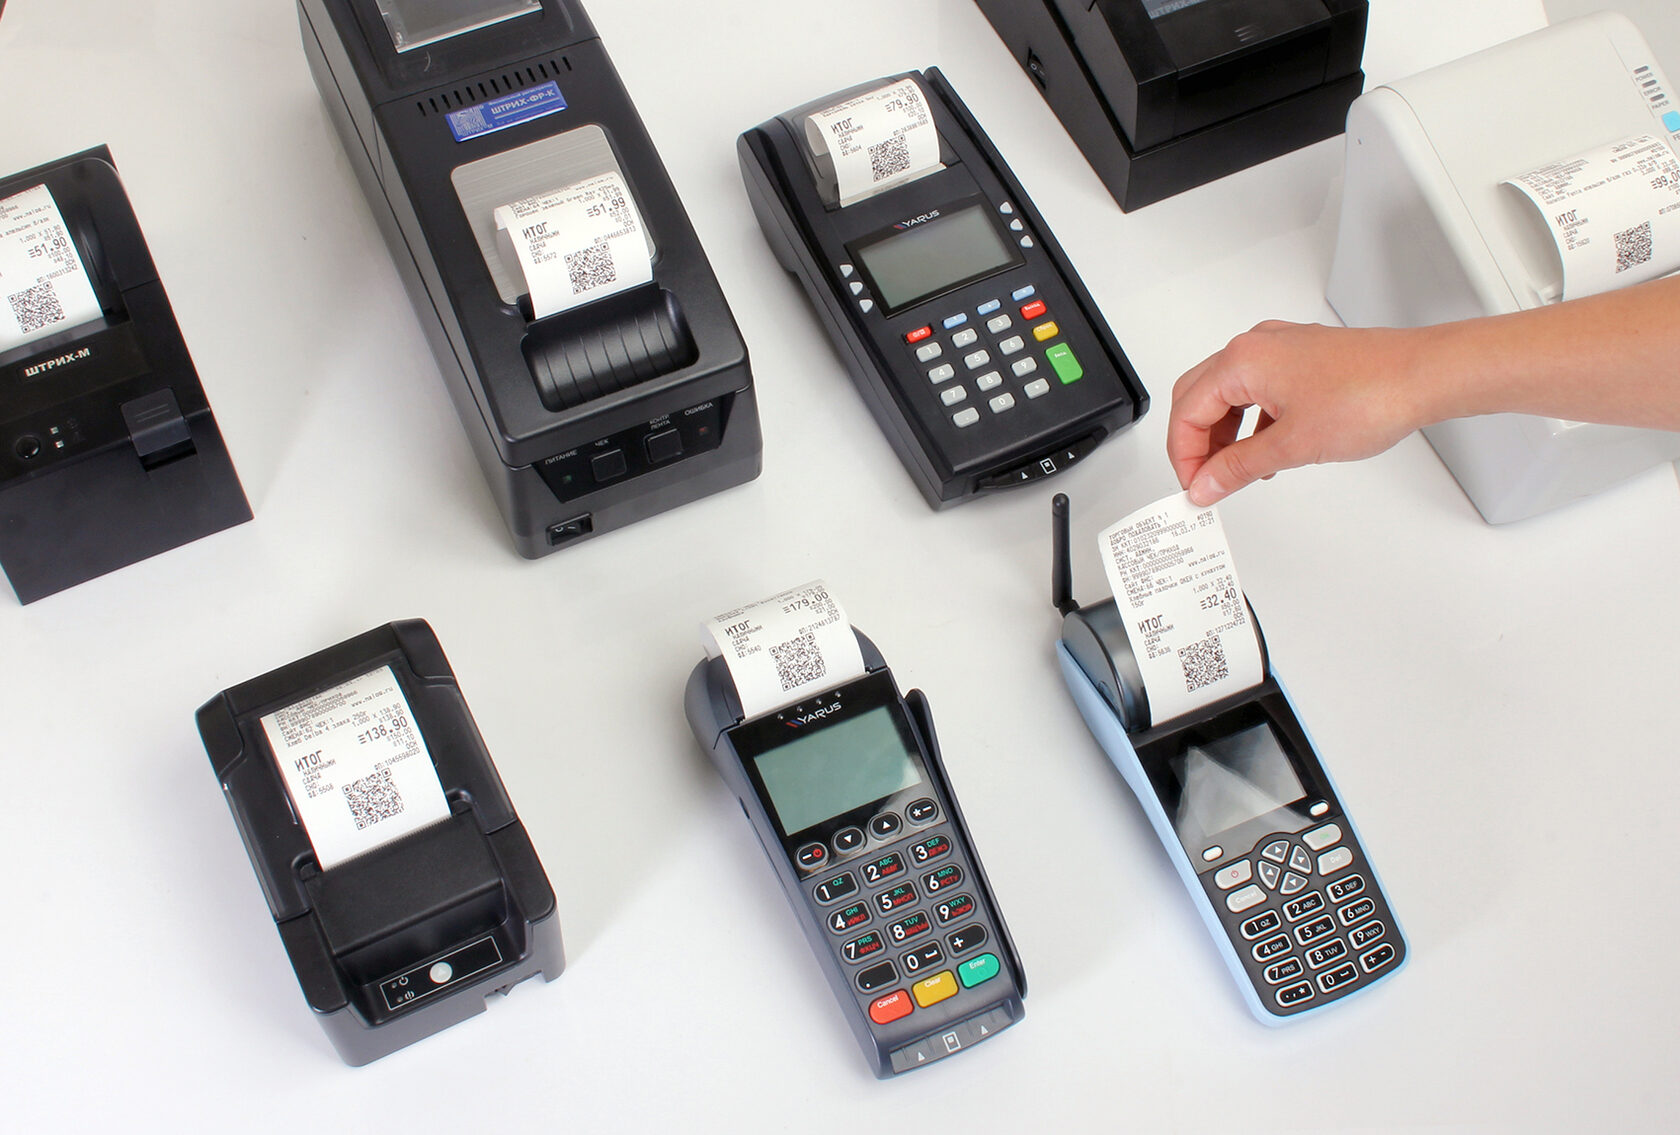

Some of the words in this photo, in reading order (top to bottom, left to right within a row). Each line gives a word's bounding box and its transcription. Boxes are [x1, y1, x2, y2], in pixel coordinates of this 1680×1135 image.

[491, 89, 556, 114] ШТРИХ-ФР-К
[831, 118, 852, 134] ИТОГ
[902, 210, 940, 227] YARUS
[1555, 209, 1577, 226] ИТОГ
[522, 222, 547, 239] ИТОГ
[24, 347, 91, 378] ШТРИХ-М
[684, 402, 713, 416] ОШИБКА
[545, 450, 578, 465] ПИТАНИЕ
[1110, 535, 1126, 546] ДОБРО
[725, 620, 749, 636] ИТОГ
[1138, 614, 1163, 633] ИТОГ
[1144, 636, 1161, 646] СДАЧА
[797, 702, 842, 724] YARUS
[295, 750, 322, 771] ИТОГ
[302, 772, 321, 785] СДАЧА
[916, 845, 928, 860] 3
[926, 838, 940, 847] DEF
[866, 865, 881, 881] 2
[879, 857, 894, 867] ABC
[929, 875, 939, 890] 6
[937, 867, 954, 877] MNO
[820, 885, 830, 900] 1
[832, 877, 844, 887] QZ
[1334, 884, 1344, 896] 3
[1345, 881, 1358, 891] DEF
[881, 894, 893, 910] 5
[893, 887, 905, 896] JKL
[939, 904, 949, 920] 9
[948, 897, 966, 907] WXY
[1292, 903, 1302, 915] 2
[1302, 899, 1317, 910] ABC
[1347, 907, 1355, 918] 6
[1355, 904, 1370, 914] MNO
[835, 914, 846, 929] 4
[845, 906, 859, 916] GHI
[893, 924, 905, 940] 8
[903, 916, 919, 926] TUV
[1251, 921, 1259, 932] 1
[1304, 926, 1312, 938] 5
[1357, 931, 1364, 942] 9
[1365, 927, 1380, 938] WXY
[846, 942, 855, 959] 7
[857, 935, 873, 946] PRS
[1263, 944, 1271, 955] 4
[1271, 941, 1283, 951] GHI
[1315, 950, 1324, 961] 8
[1324, 946, 1338, 957] TUV
[906, 954, 919, 970] 0
[968, 958, 986, 970] Enter
[1272, 967, 1280, 978] 7
[1281, 964, 1296, 975] PRS
[924, 977, 941, 988] Clear
[1326, 974, 1335, 985] 0
[877, 995, 899, 1009] Cancel
